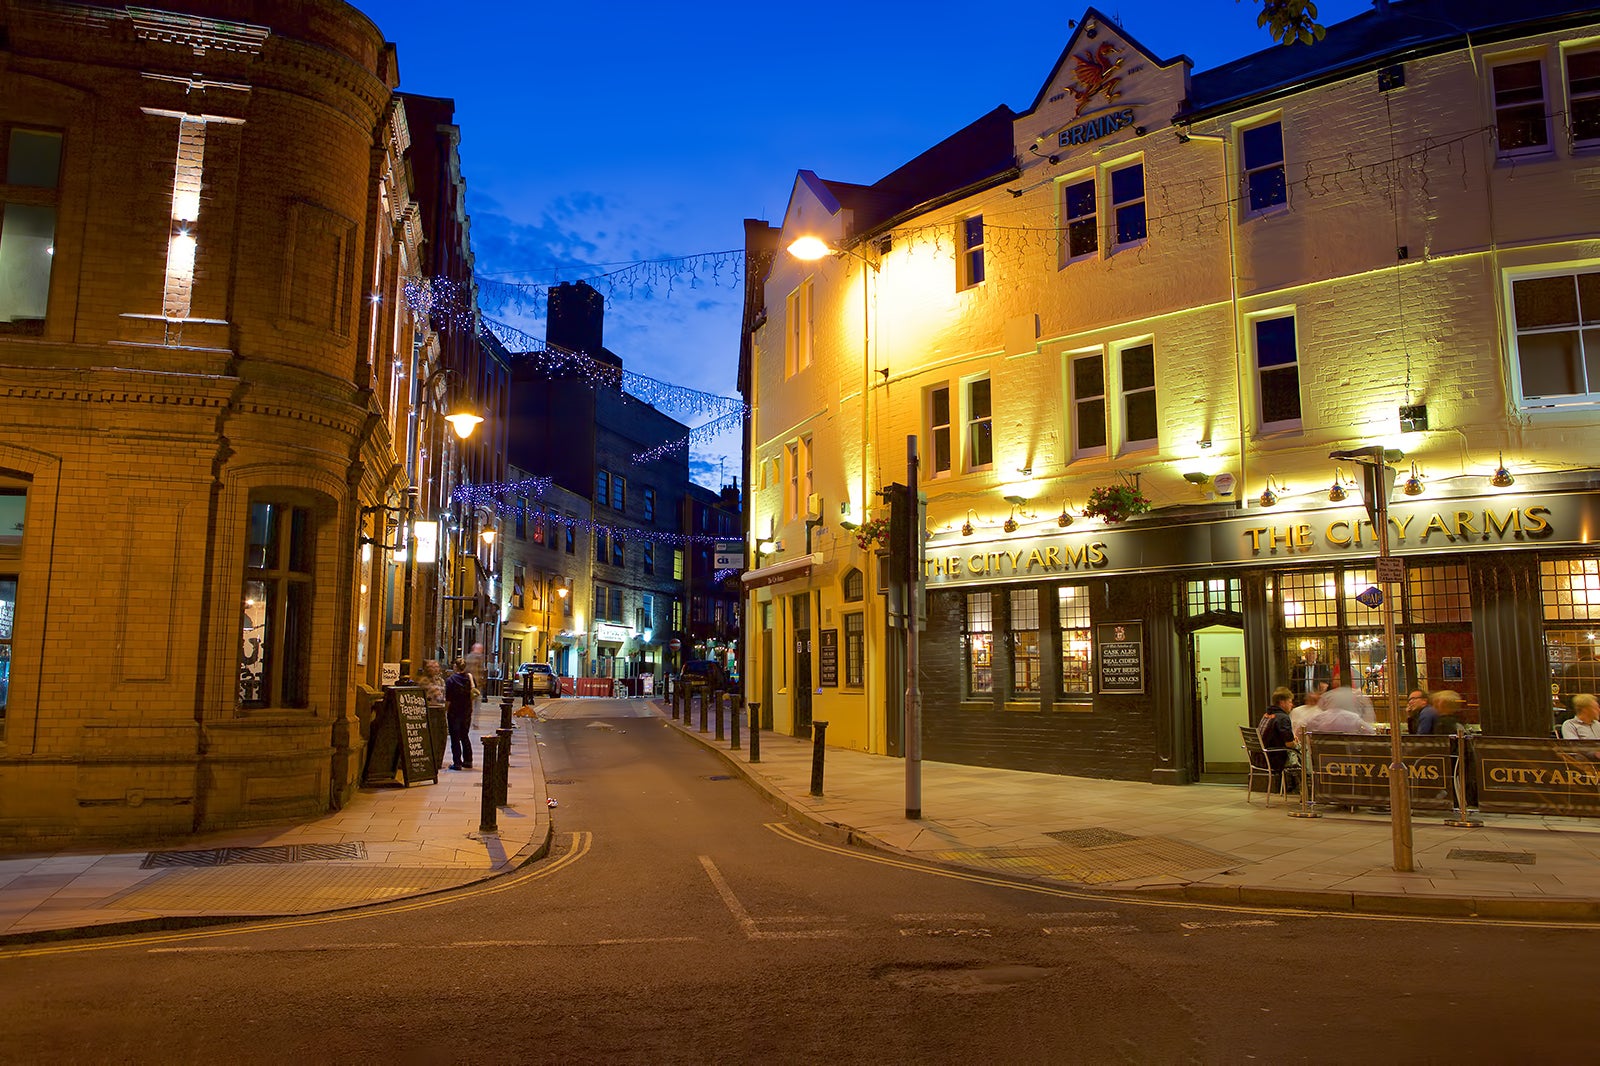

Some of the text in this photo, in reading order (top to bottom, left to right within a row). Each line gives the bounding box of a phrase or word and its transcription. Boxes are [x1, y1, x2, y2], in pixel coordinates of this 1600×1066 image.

[1246, 504, 1553, 550] THE CITY ARMS
[924, 541, 1107, 577] THE CITY ARMS
[404, 694, 425, 706] Urban
[1326, 762, 1439, 780] CITY AMS
[1490, 767, 1546, 783] CITY
